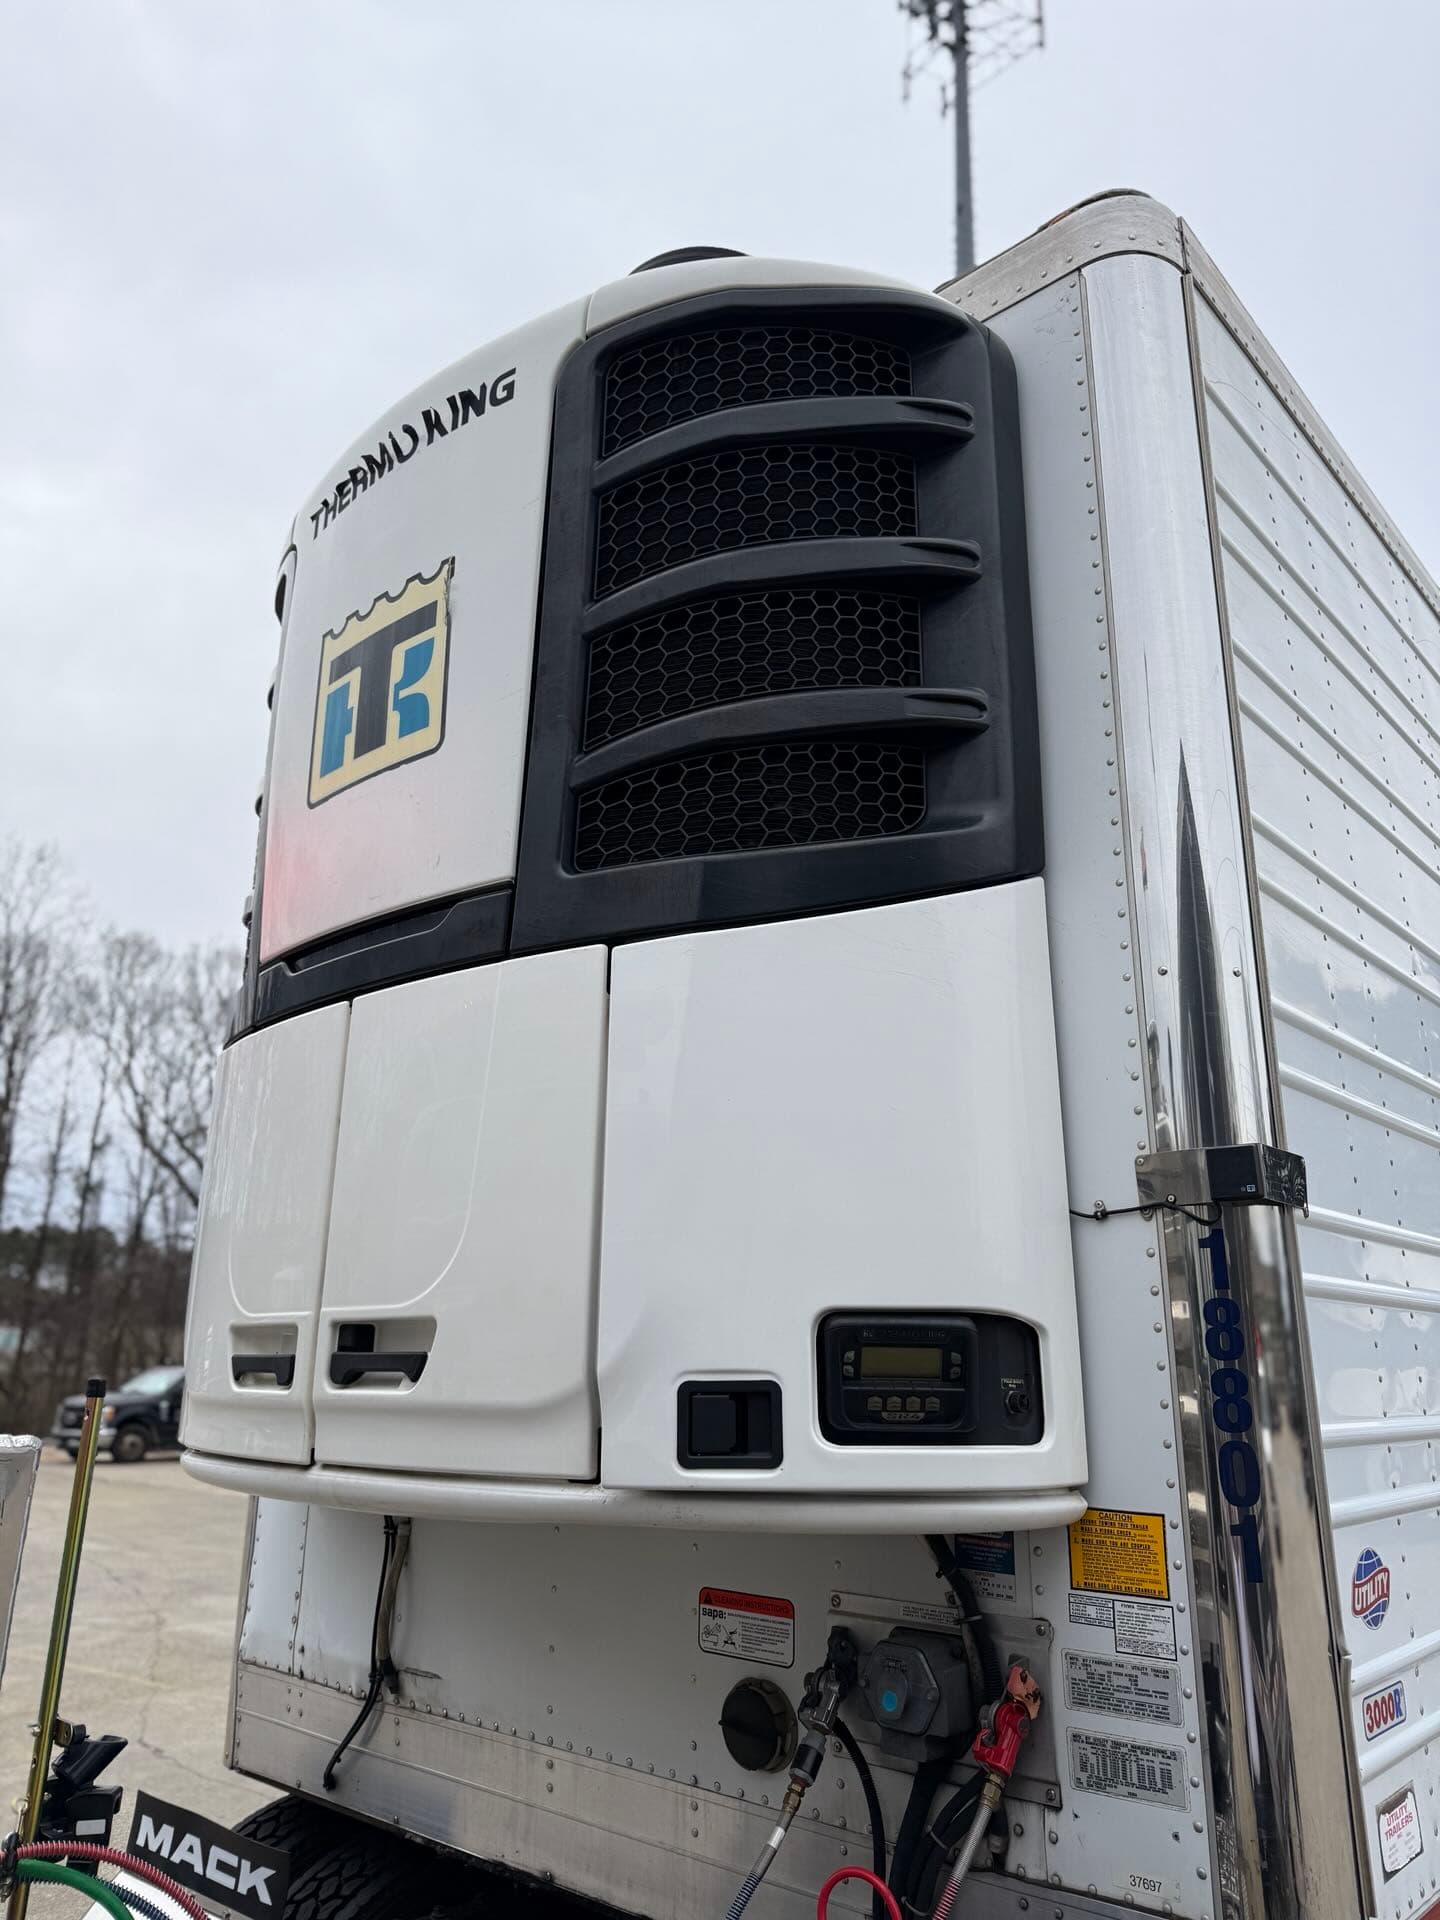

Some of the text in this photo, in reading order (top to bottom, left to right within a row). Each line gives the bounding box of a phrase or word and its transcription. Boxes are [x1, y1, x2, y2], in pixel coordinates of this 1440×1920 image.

[421, 366, 517, 446] KING
[1198, 1228, 1264, 1584] 18801
[1098, 1512, 1133, 1522] CAUTION
[1354, 1572, 1389, 1612] UTILITY
[1385, 1812, 1414, 1841] TRAILERS
[1386, 1802, 1408, 1826] UTILITY
[136, 1814, 276, 1906] MACK
[1129, 1874, 1162, 1893] 37697
